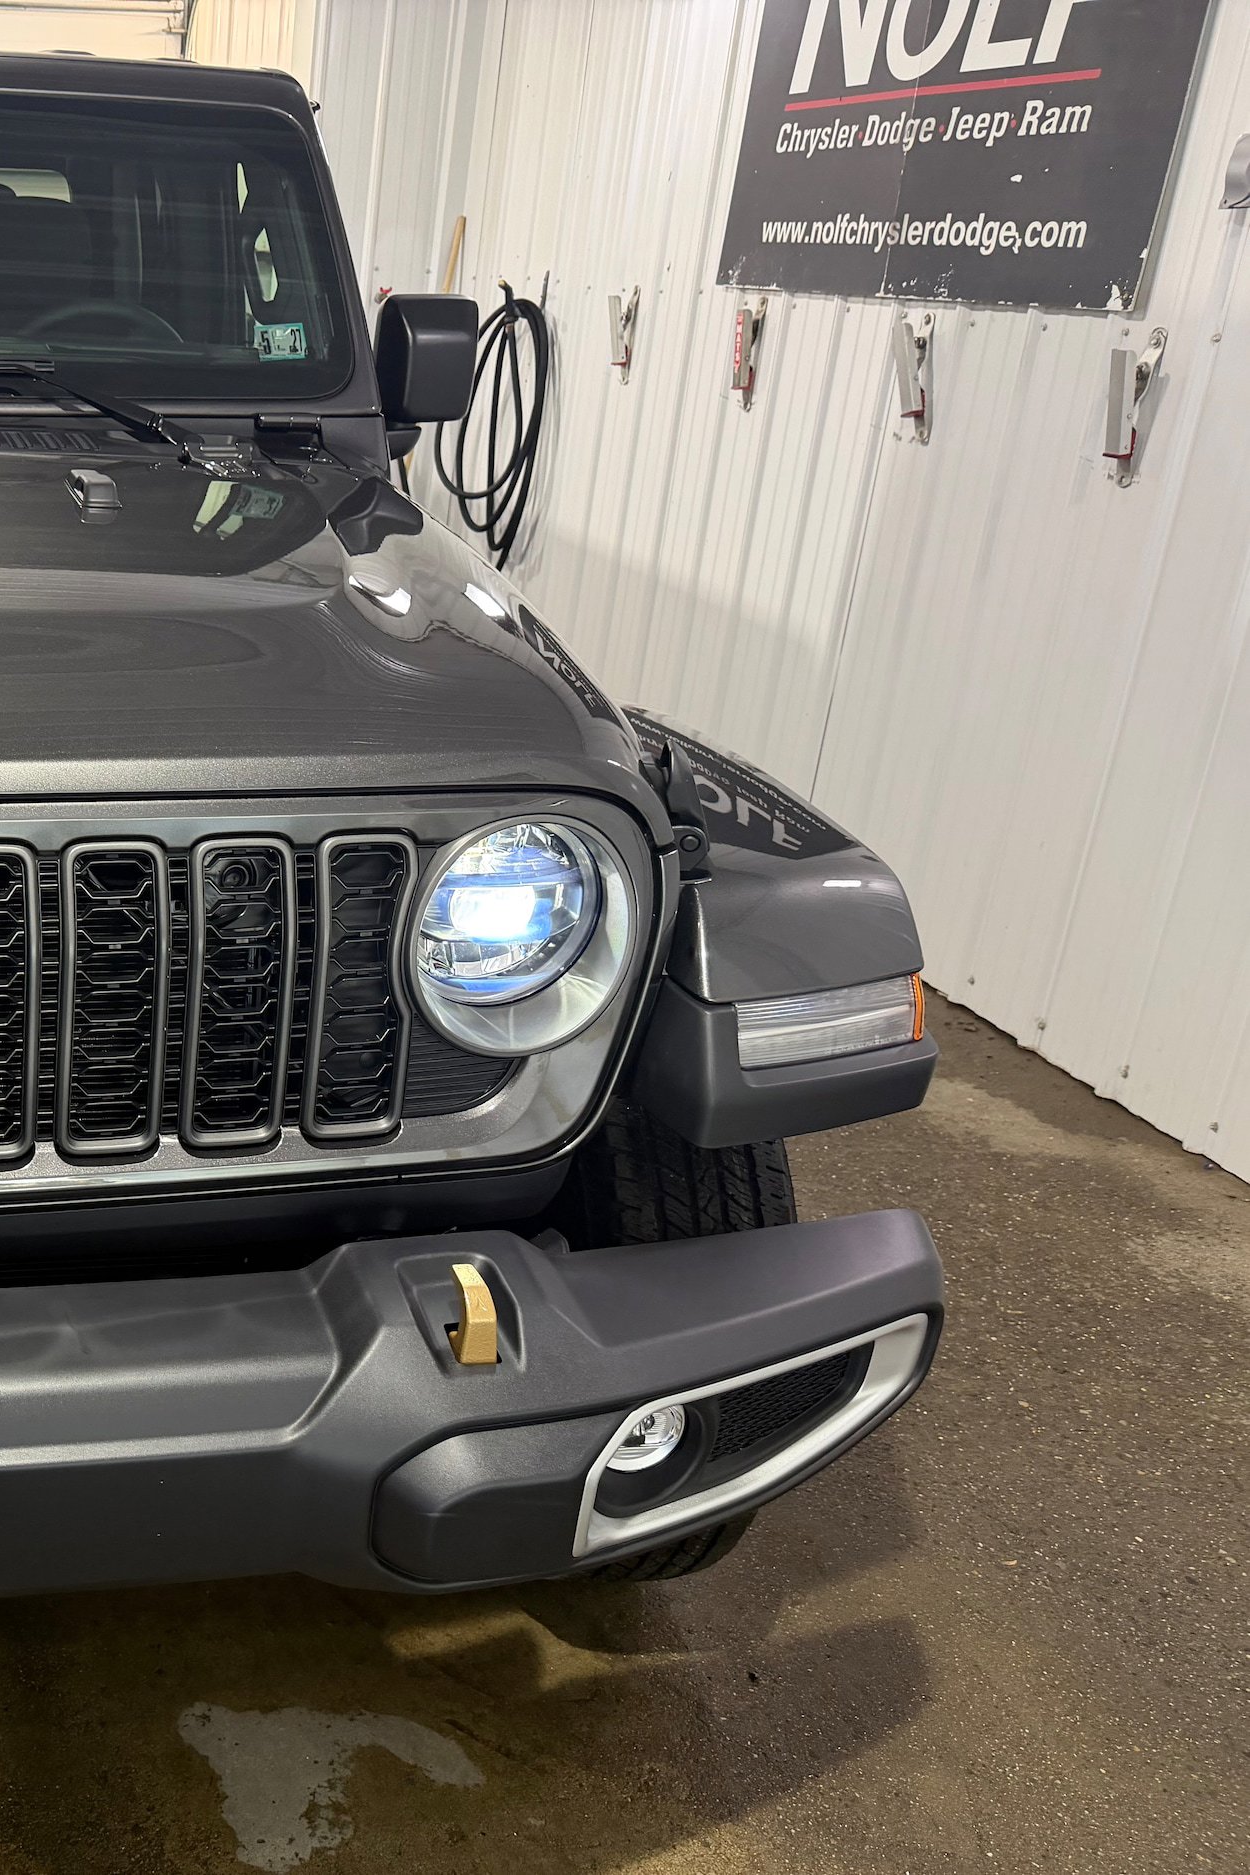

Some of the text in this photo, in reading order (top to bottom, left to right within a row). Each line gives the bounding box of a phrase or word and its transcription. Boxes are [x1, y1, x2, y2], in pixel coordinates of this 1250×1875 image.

[775, 99, 1093, 159] Chrysler Dodge Jeep Ram
[761, 212, 1088, 256] www.nolfchryslerdodge.com
[260, 331, 271, 354] 5
[289, 329, 302, 352] 27
